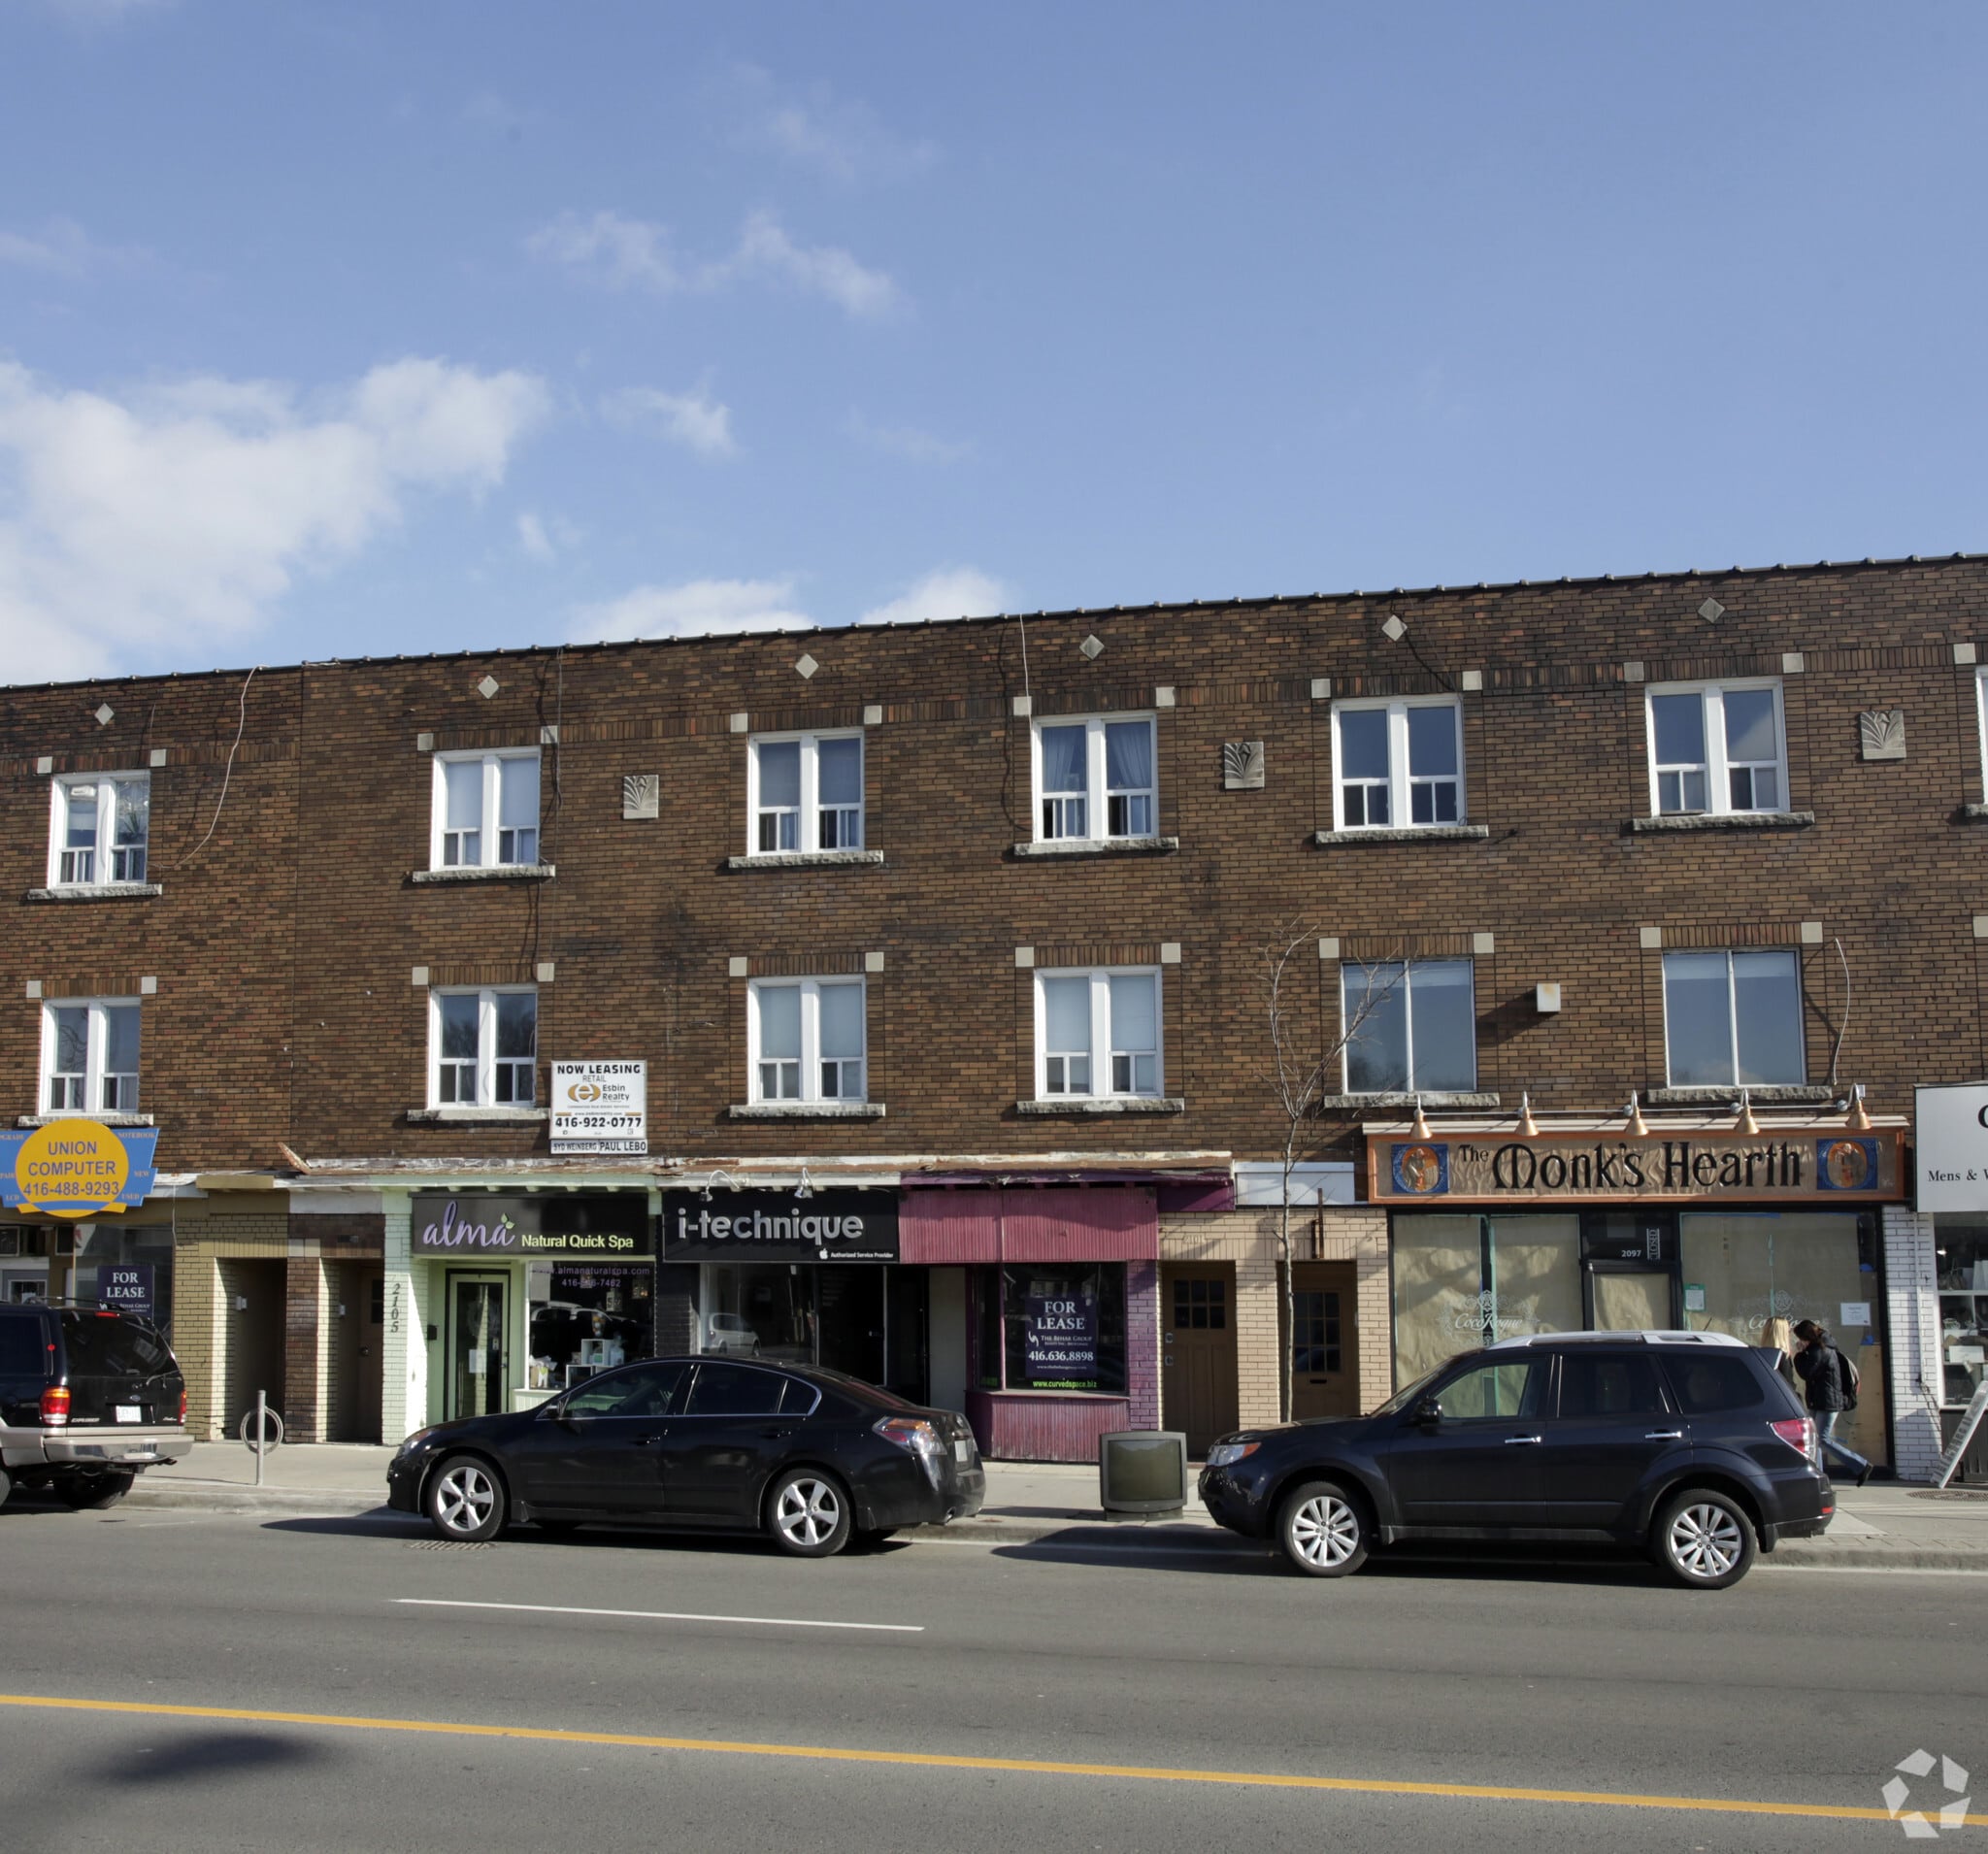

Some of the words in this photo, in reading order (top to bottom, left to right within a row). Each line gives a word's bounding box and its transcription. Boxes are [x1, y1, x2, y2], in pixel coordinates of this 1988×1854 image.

[557, 1065, 584, 1075] NOW
[589, 1064, 641, 1075] LEASING
[555, 1117, 642, 1128] 416-922-0777
[48, 1141, 97, 1156] UNION
[567, 1142, 597, 1151] WEINBERG
[599, 1142, 622, 1151] PAUL
[624, 1141, 646, 1151] LEBO
[28, 1160, 116, 1176] COMPUTER
[1458, 1143, 1490, 1163] The
[1492, 1142, 1645, 1190] Monk's
[1662, 1141, 1802, 1188] Hearth
[1928, 1170, 1962, 1181] Mens
[1966, 1169, 1977, 1180] &
[23, 1180, 120, 1196] 416-488-9293
[423, 1200, 515, 1247] alma
[679, 1208, 864, 1246] i-technique
[522, 1235, 566, 1248] Natural
[569, 1234, 605, 1248] Quick
[609, 1235, 634, 1250] Spa
[1621, 1249, 1641, 1258] 2097
[112, 1272, 139, 1283] FOR
[107, 1286, 146, 1298] LEASE
[390, 1282, 401, 1334] 2105
[1044, 1301, 1077, 1313] FOR
[1037, 1316, 1085, 1330] LEASE
[1029, 1350, 1094, 1361] 416.636.8898
